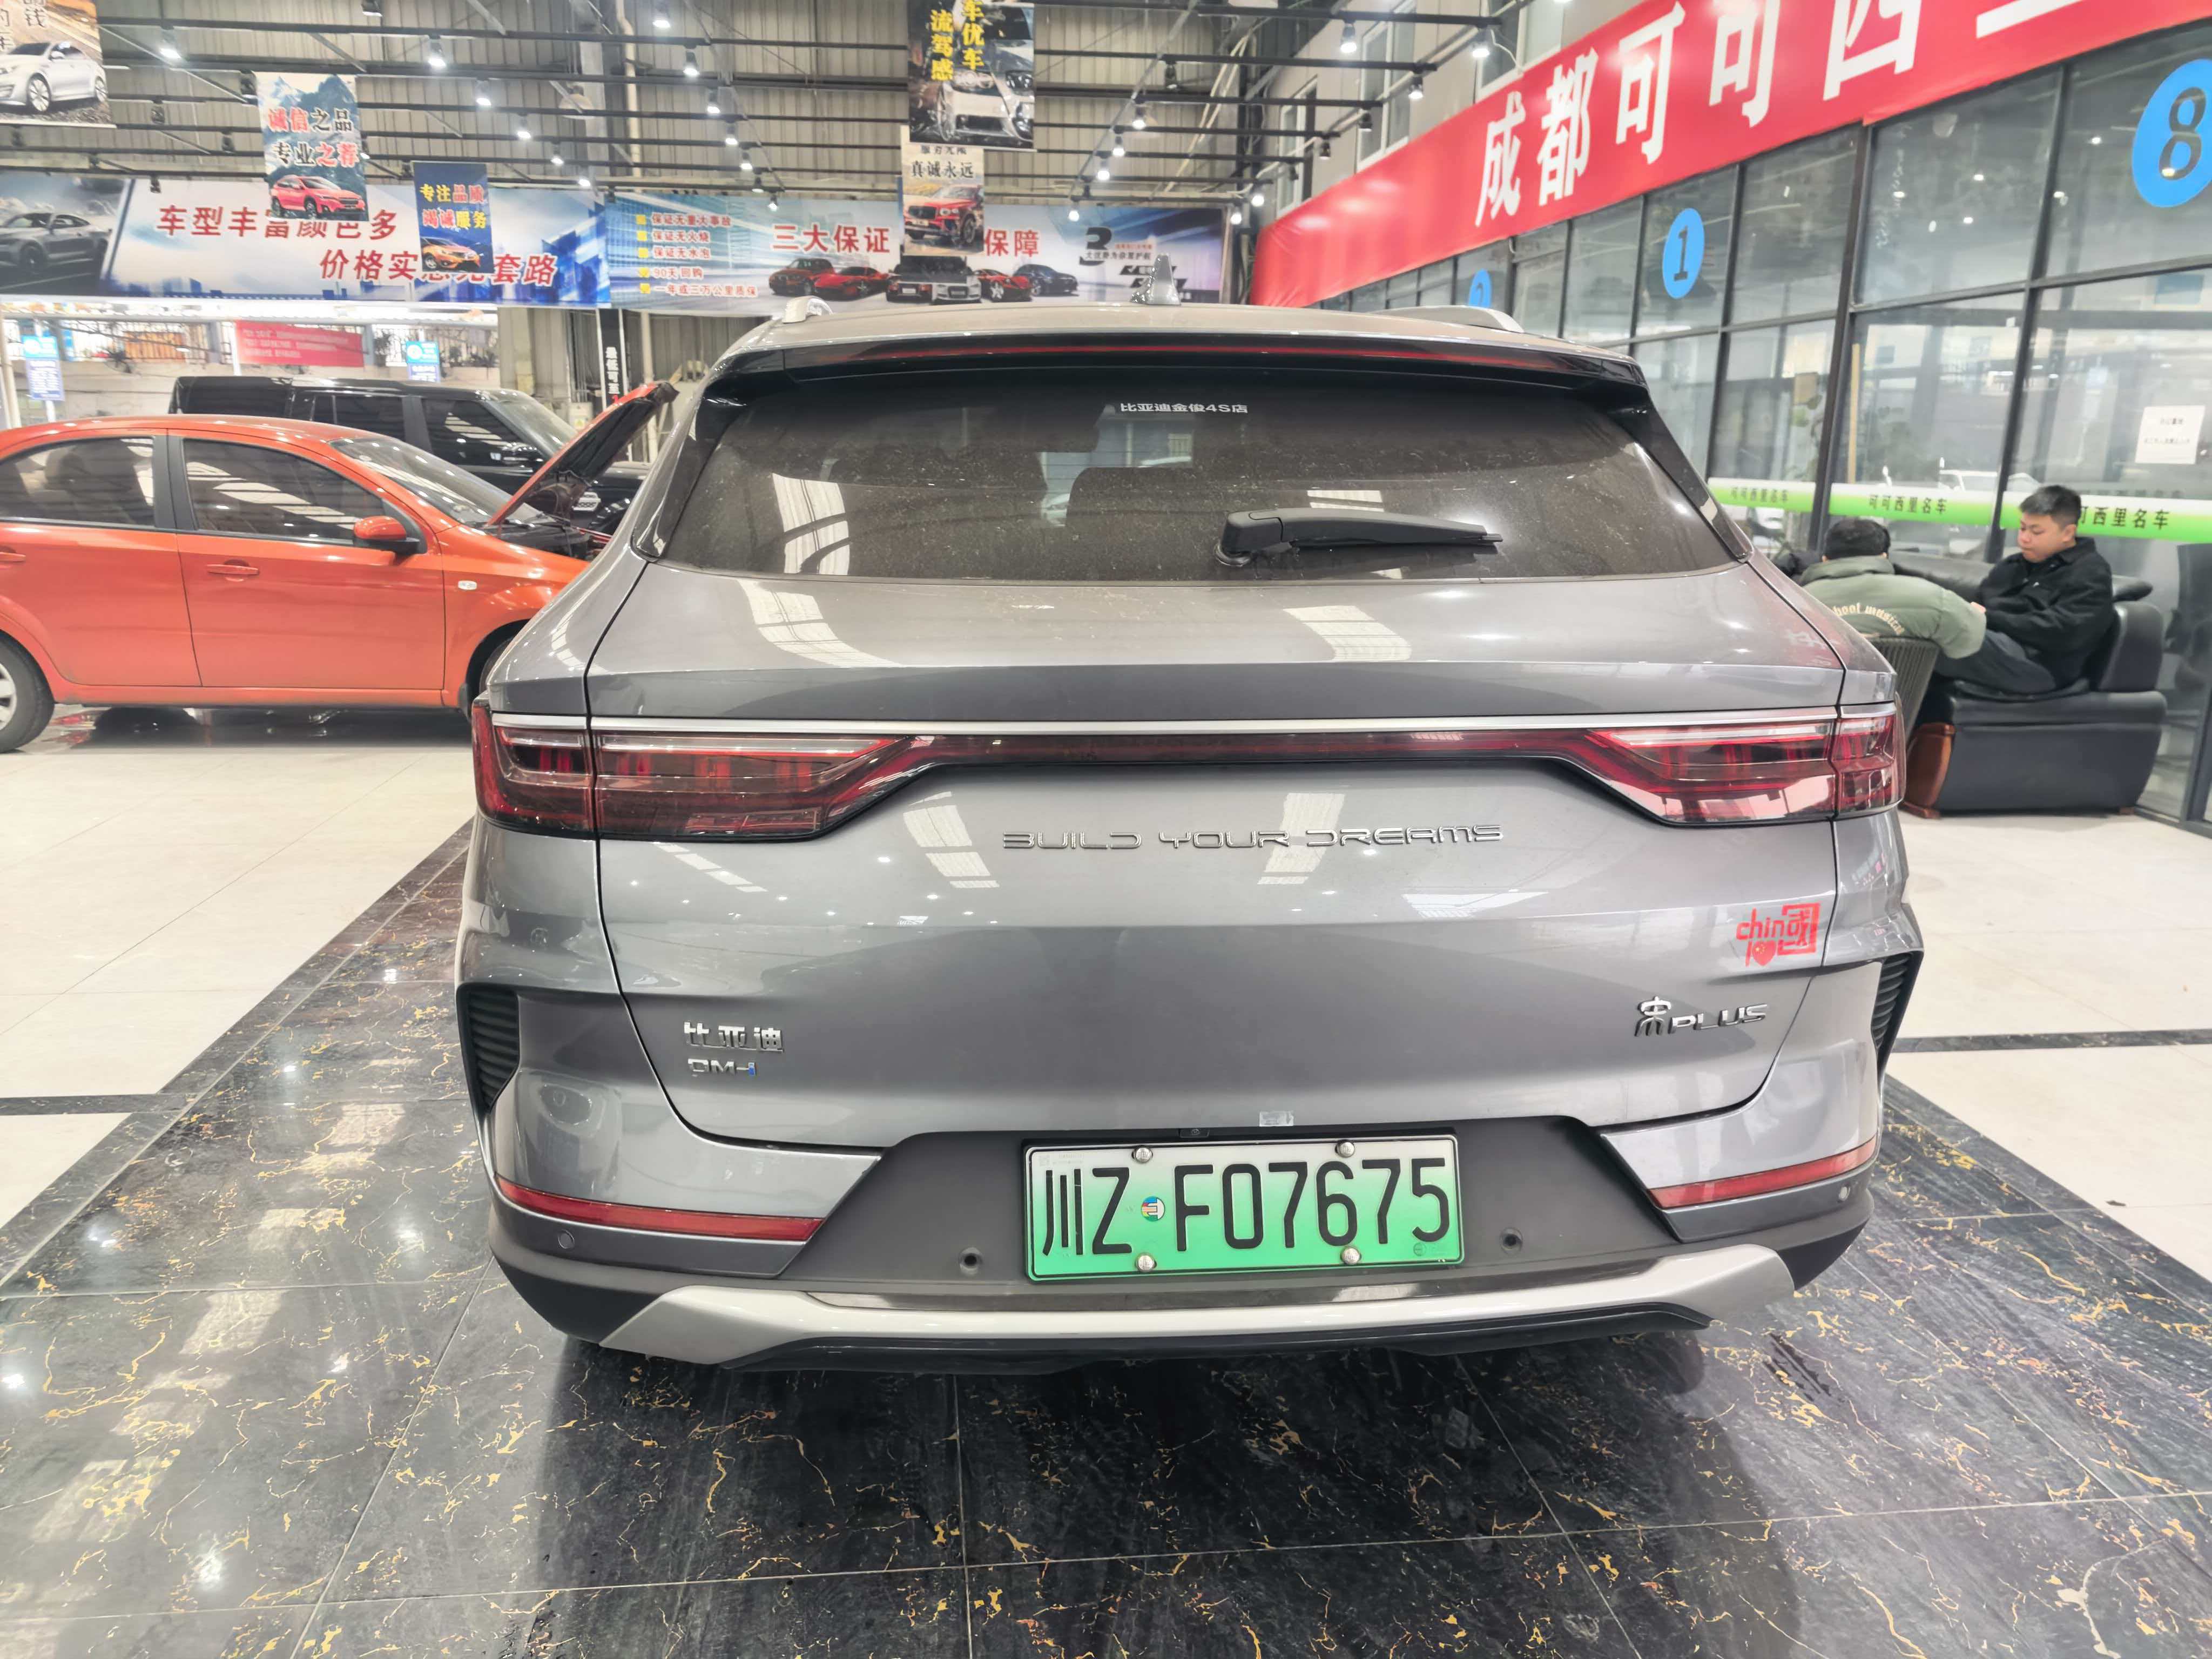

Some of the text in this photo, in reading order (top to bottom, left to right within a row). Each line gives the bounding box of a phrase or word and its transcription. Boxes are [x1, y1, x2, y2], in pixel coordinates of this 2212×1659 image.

[2159, 86, 2207, 180] 8
[912, 160, 974, 178] 真诚永远
[772, 224, 1040, 257] 三大保证 保障
[1673, 225, 1691, 281] 1
[319, 248, 558, 286] 价格实套路
[1869, 494, 1947, 514] 可可西里名车
[1003, 824, 1503, 849] BUILD YOUR DREAMS
[683, 1021, 785, 1053] 比亚迪
